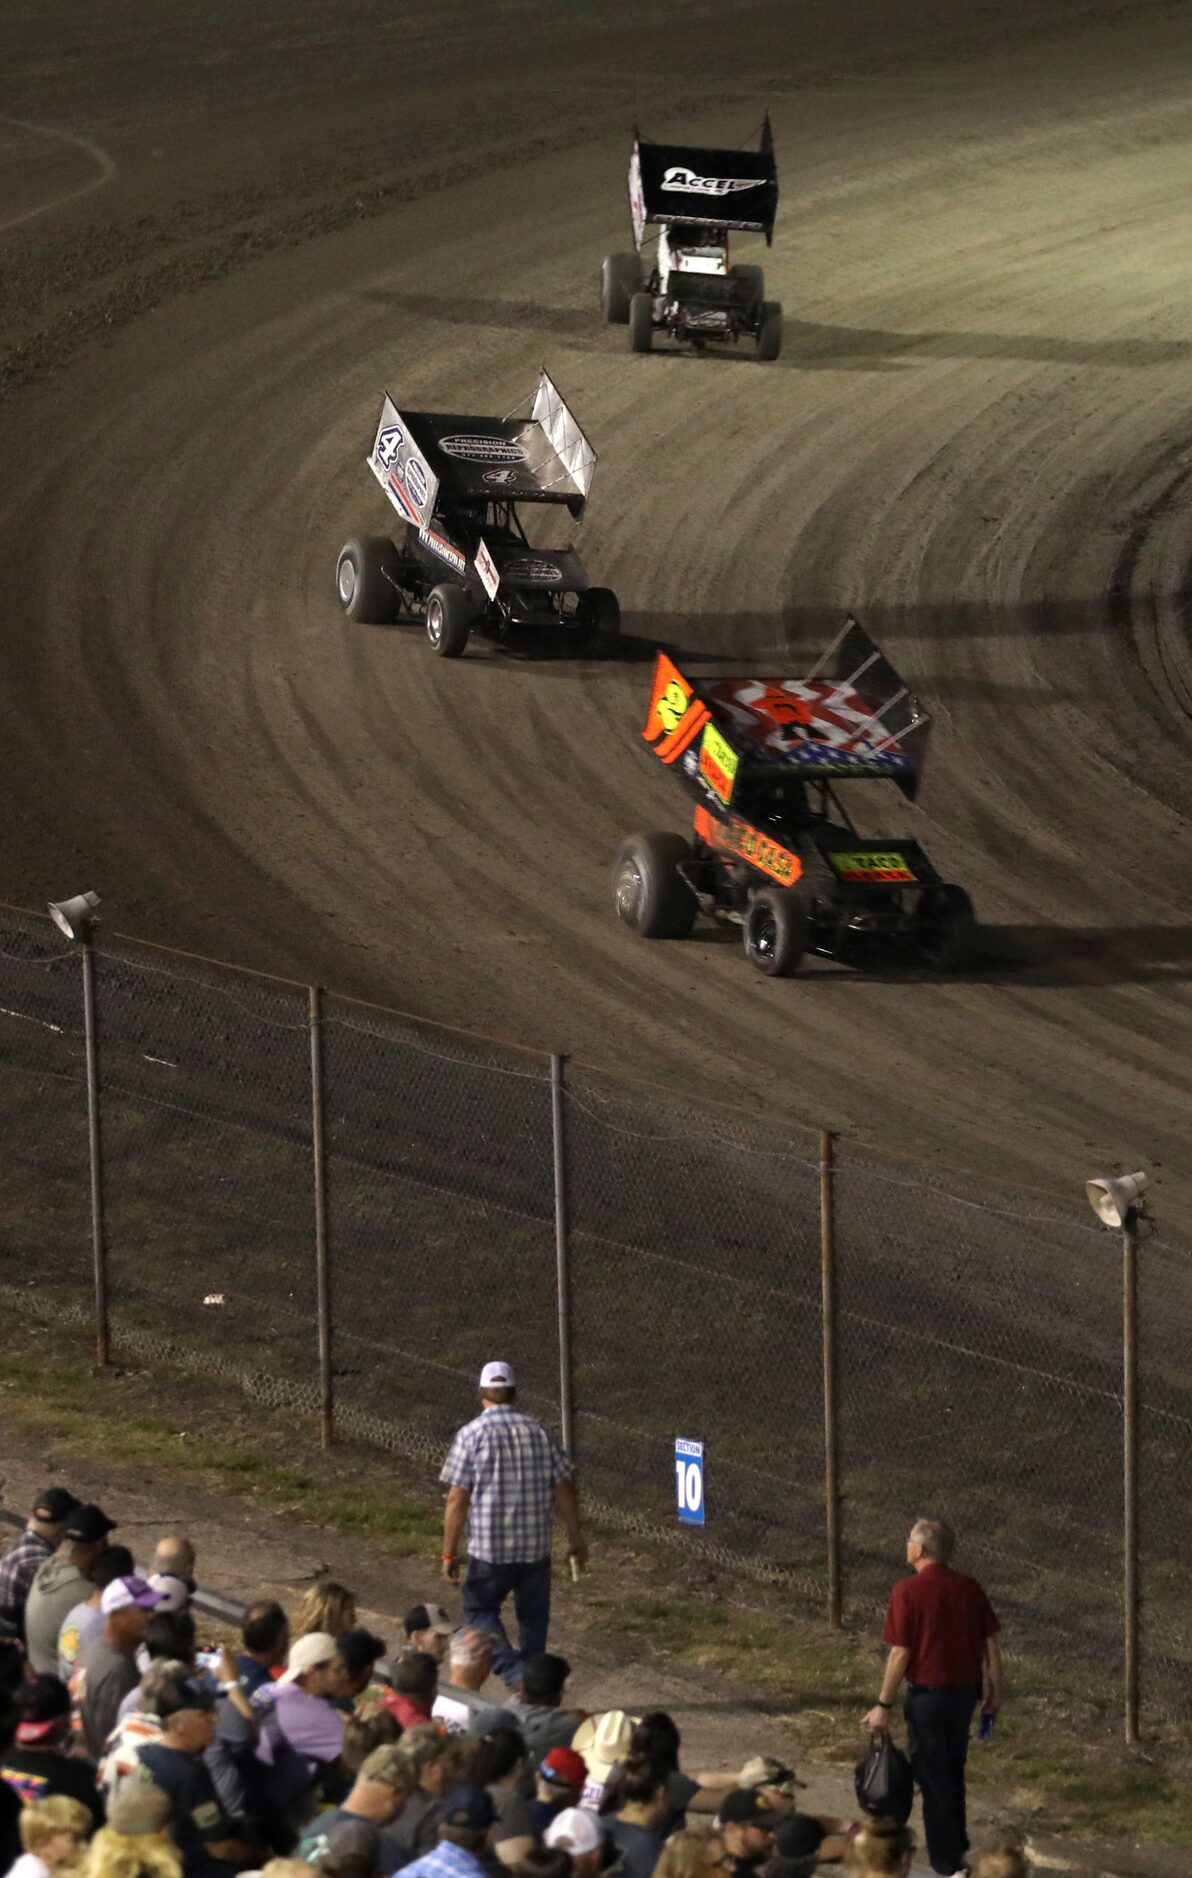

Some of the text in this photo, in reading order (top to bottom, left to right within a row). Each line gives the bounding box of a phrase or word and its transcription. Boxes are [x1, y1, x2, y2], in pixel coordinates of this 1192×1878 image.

[666, 172, 736, 190] ACCEL
[376, 424, 405, 472] 4
[454, 438, 507, 447] PRECISION
[482, 468, 518, 485] 4
[676, 1441, 701, 1454] SECTION
[676, 1460, 702, 1512] 10
